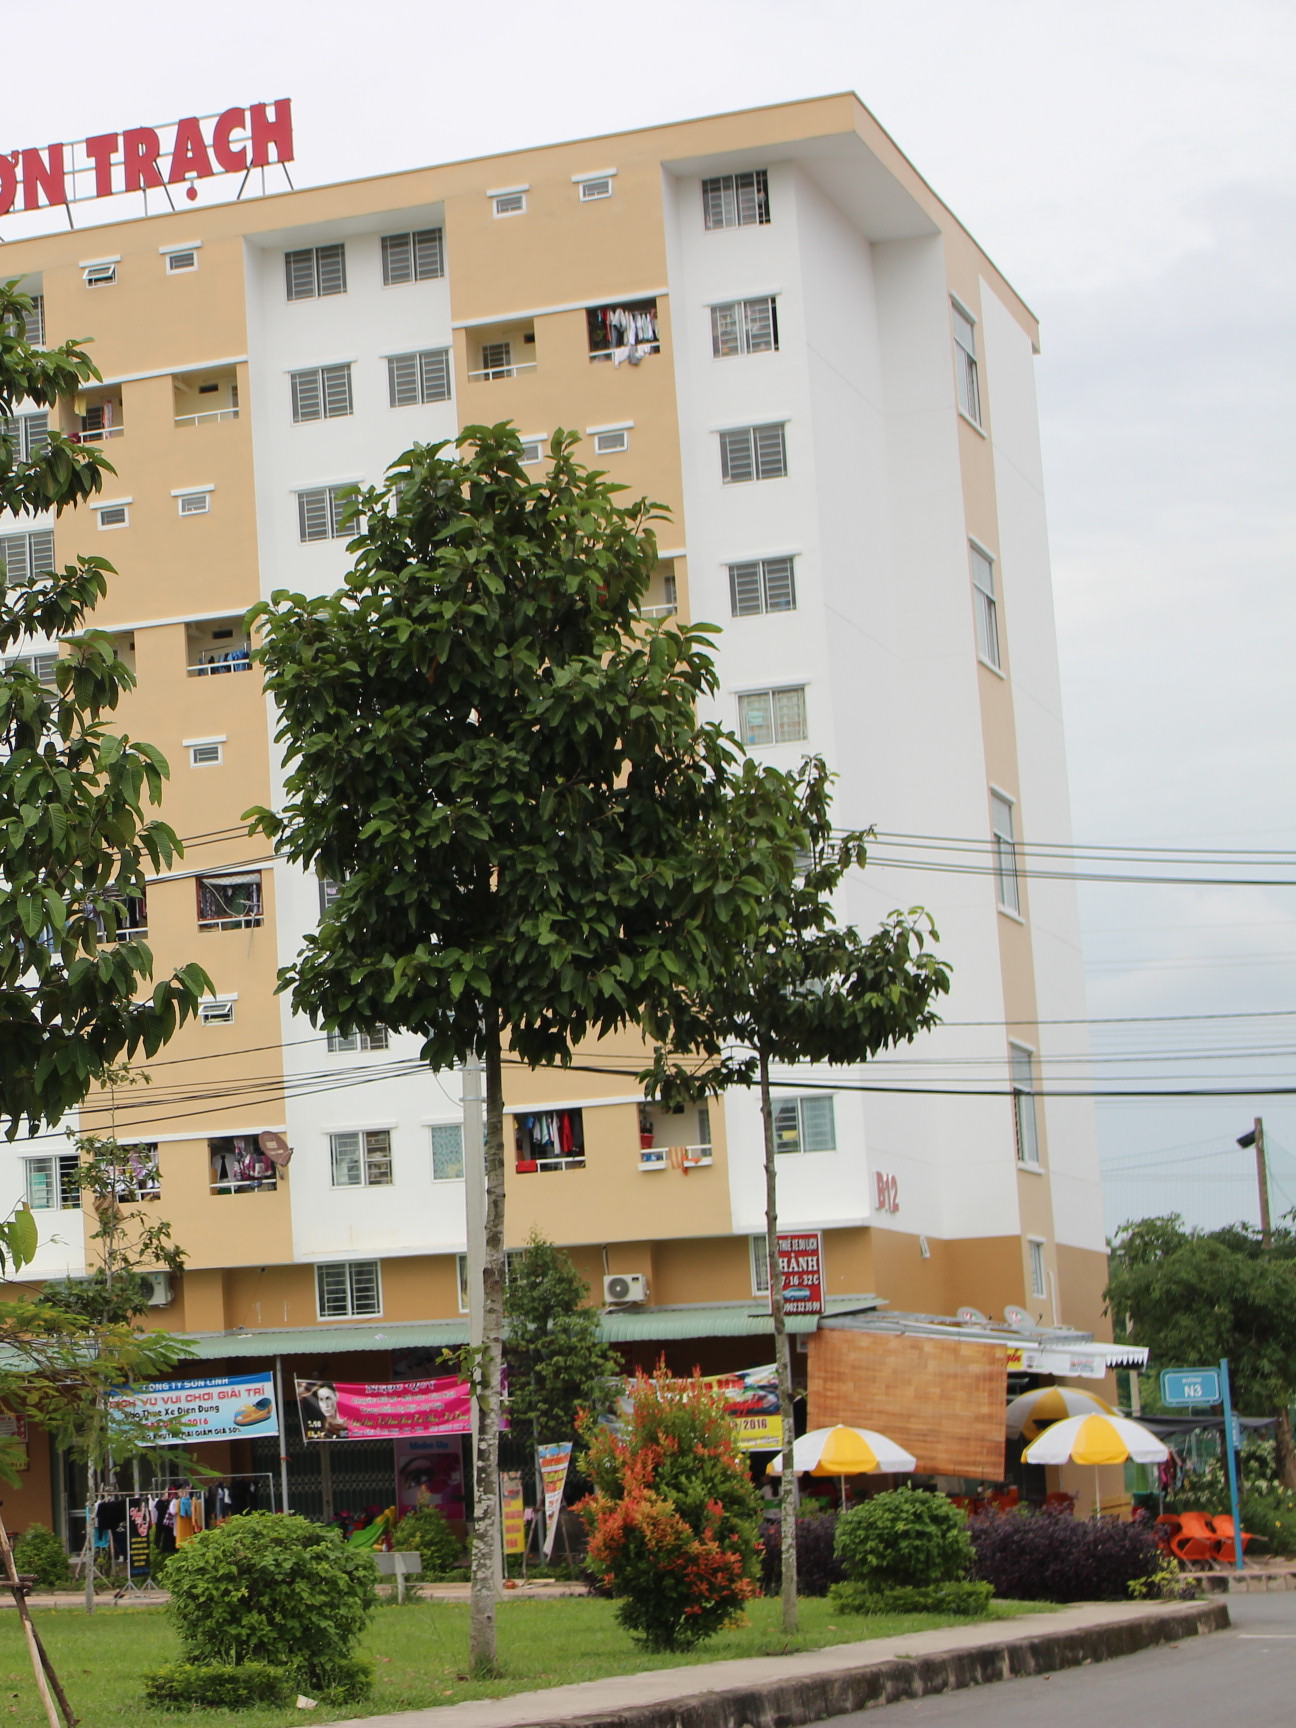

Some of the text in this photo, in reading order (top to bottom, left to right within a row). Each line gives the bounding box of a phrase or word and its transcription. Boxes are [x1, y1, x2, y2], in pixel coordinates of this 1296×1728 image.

[85, 97, 296, 201] TRẠCH
[876, 1171, 899, 1213] B12
[1184, 1384, 1202, 1397] N3
